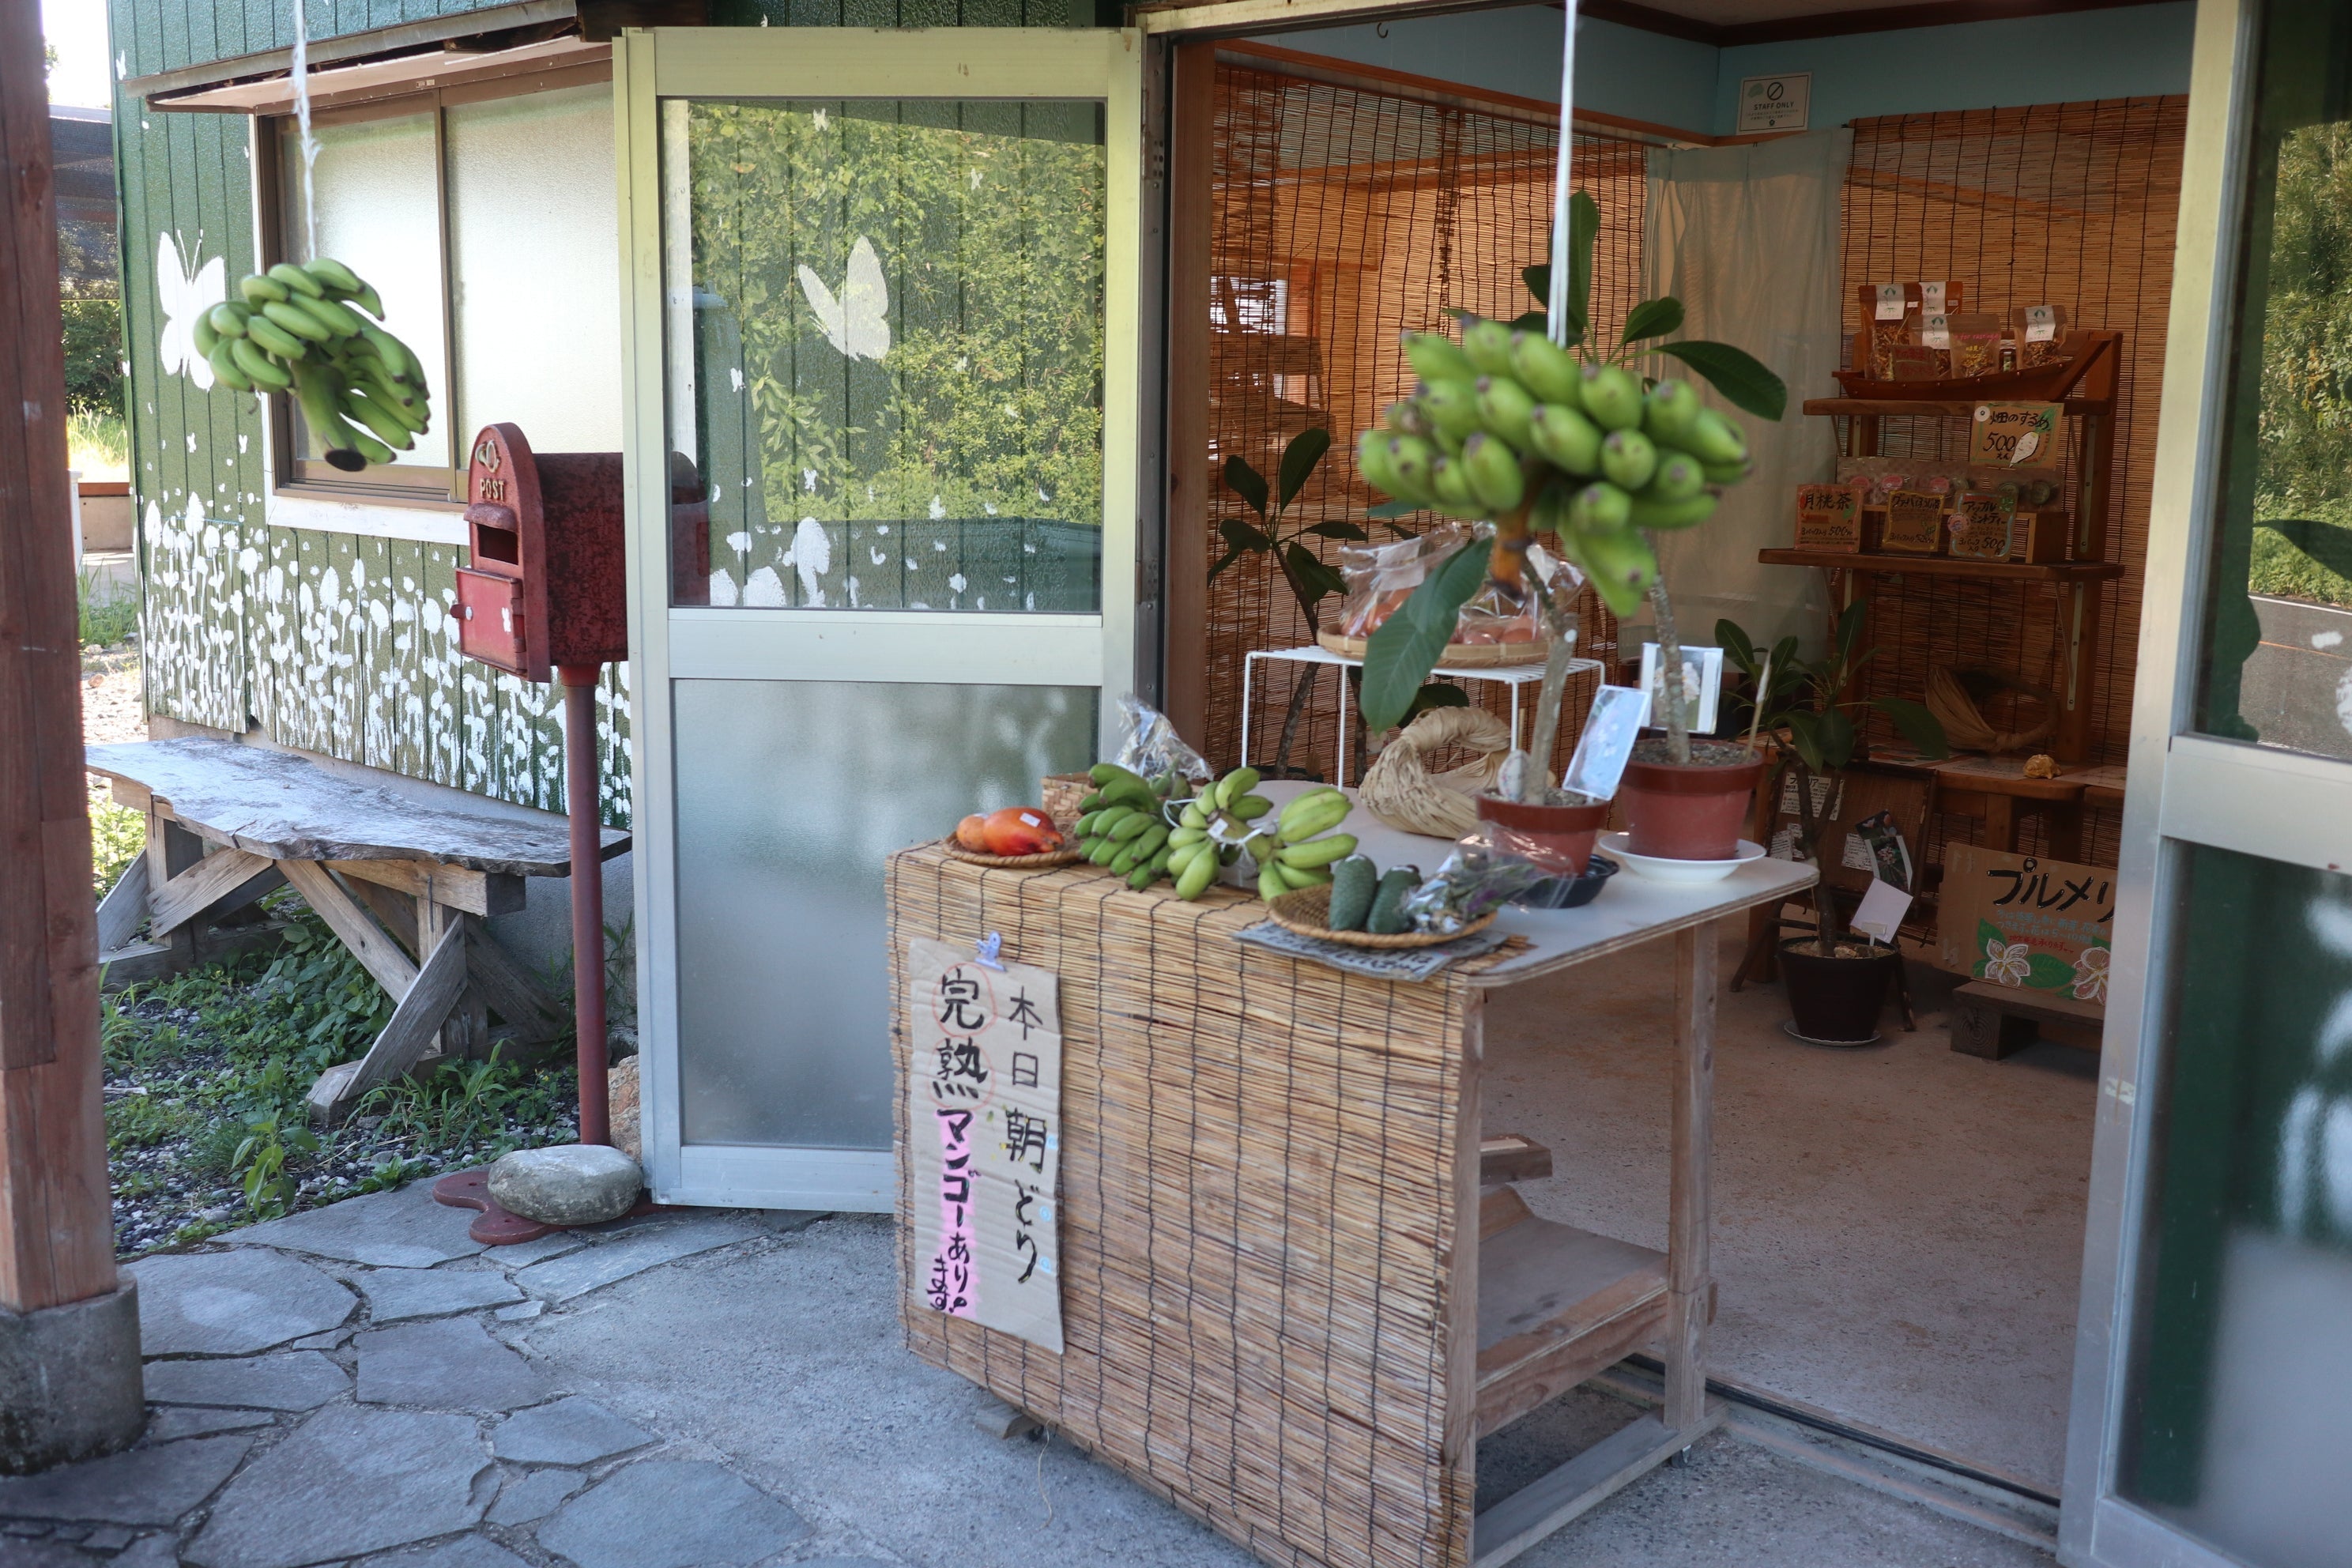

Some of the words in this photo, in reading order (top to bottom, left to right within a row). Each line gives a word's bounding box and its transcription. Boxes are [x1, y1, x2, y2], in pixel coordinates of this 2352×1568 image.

[1776, 100, 1795, 109] ONLY
[1988, 410, 2052, 432] 畑のするめ
[1982, 431, 2017, 452] 500
[479, 477, 506, 501] POST
[1804, 492, 1853, 511] 月桃茶
[1003, 985, 1048, 1284] 本日朝どり
